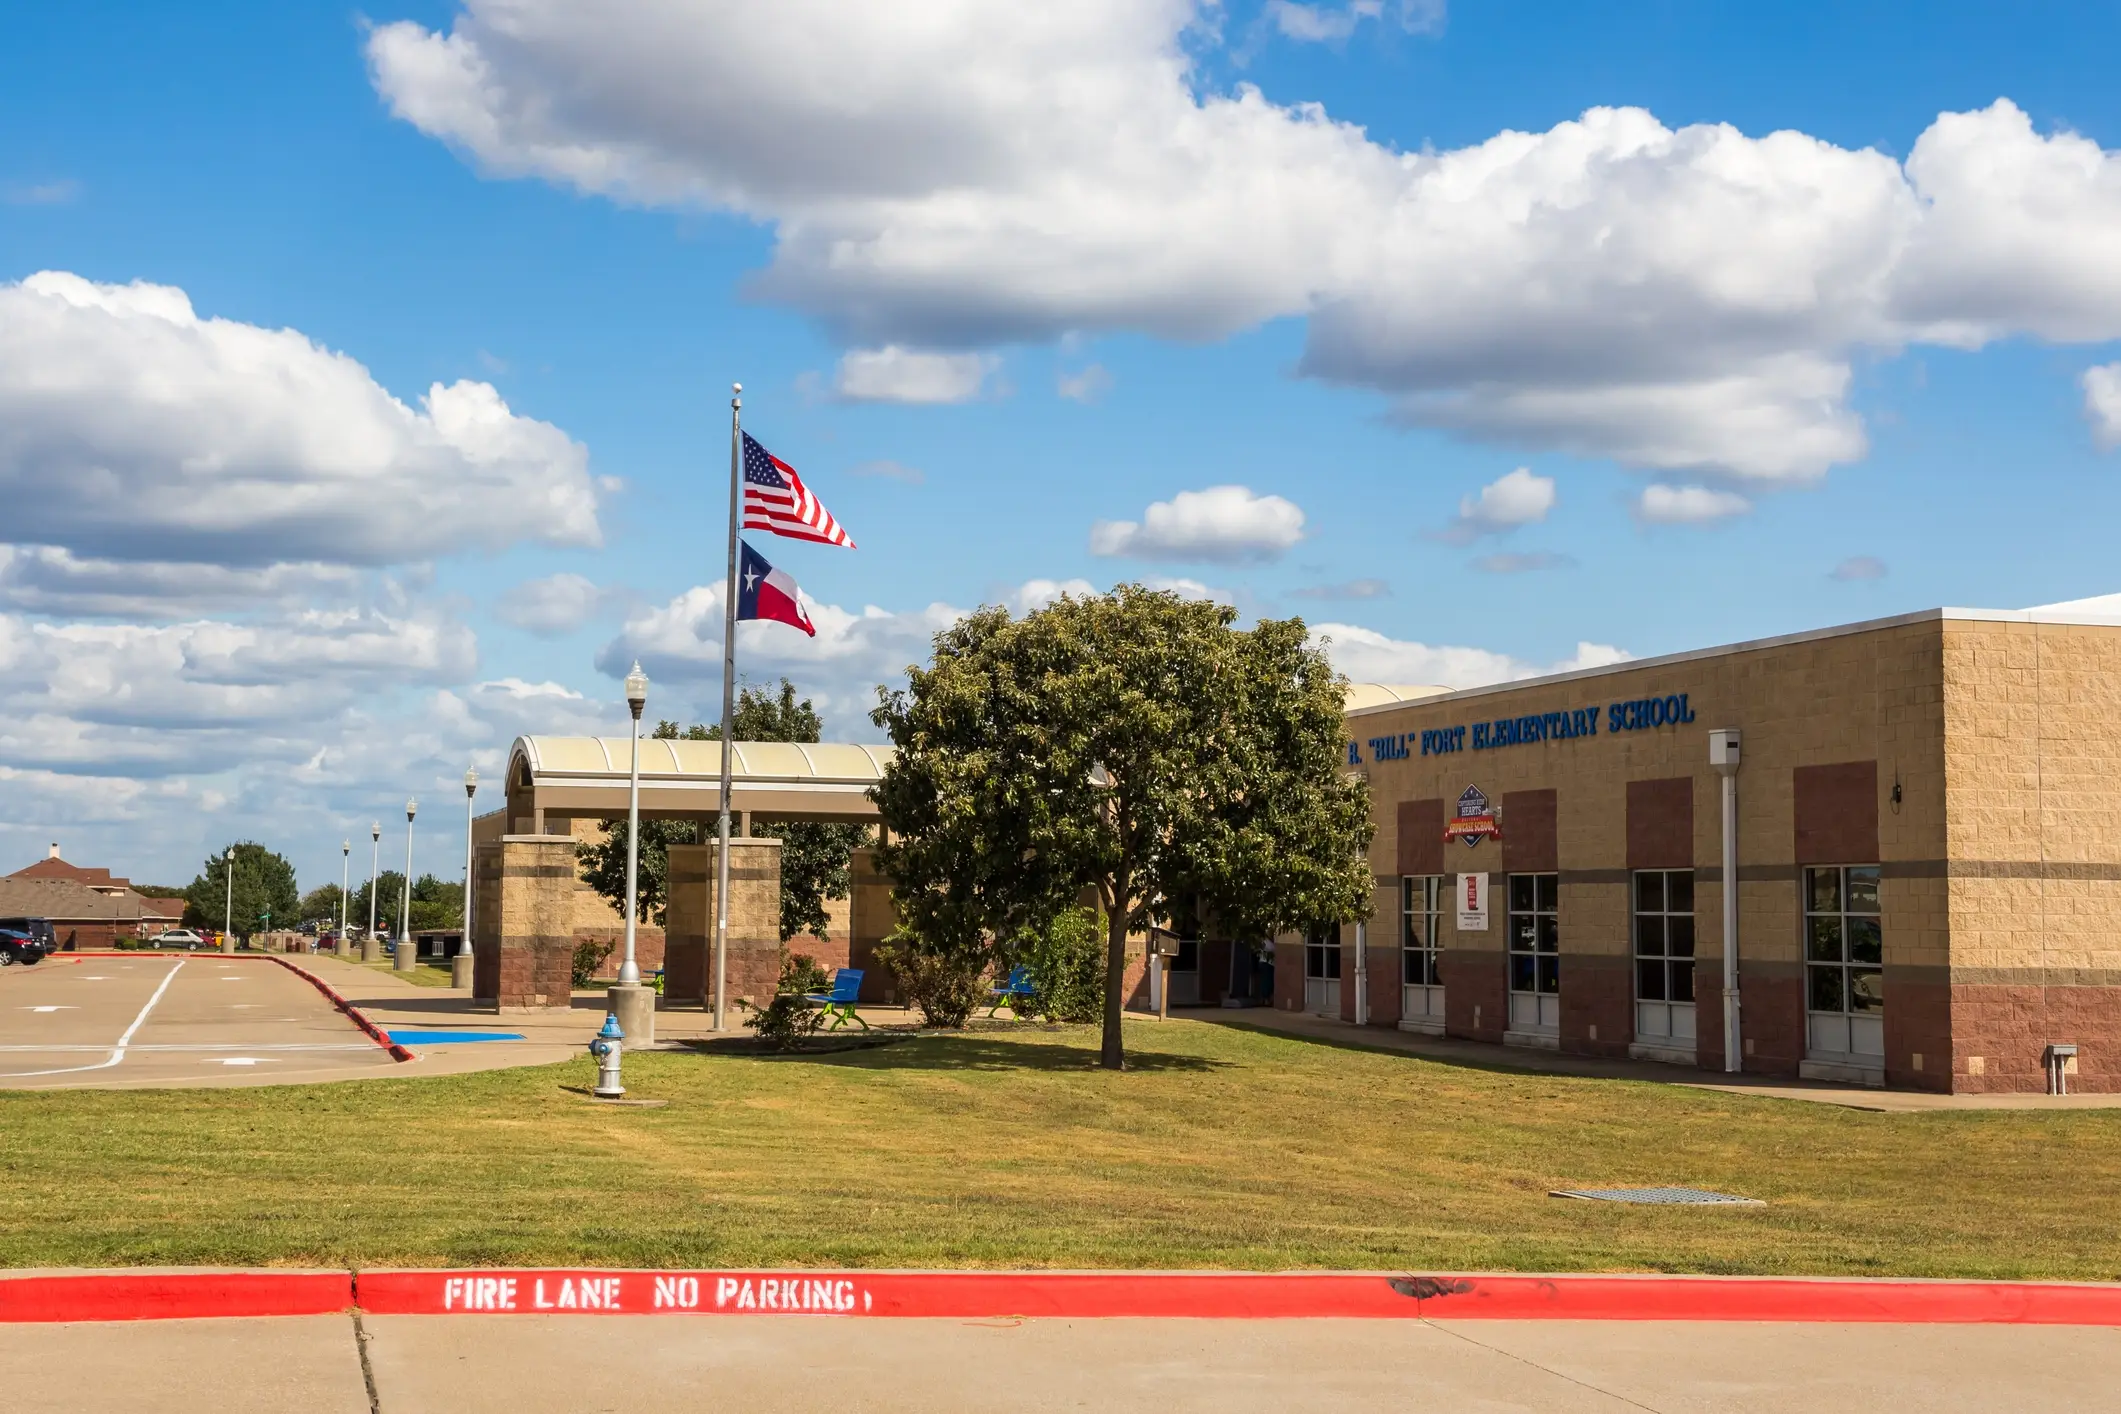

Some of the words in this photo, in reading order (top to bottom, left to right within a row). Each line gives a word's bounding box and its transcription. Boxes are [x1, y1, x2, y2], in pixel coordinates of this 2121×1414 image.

[1348, 741, 1362, 765] R.
[1368, 732, 1416, 762] "BILL"
[1421, 726, 1465, 755] FORT
[1472, 707, 1600, 749] ELEMENTARY
[1609, 694, 1695, 732] SCHOOL
[1461, 806, 1481, 816] HEARTS
[1474, 821, 1494, 832] SCHOOL
[445, 1278, 516, 1309] FIRE
[534, 1278, 621, 1309] LANE
[653, 1276, 699, 1308] NO
[716, 1279, 855, 1311] PARKING
